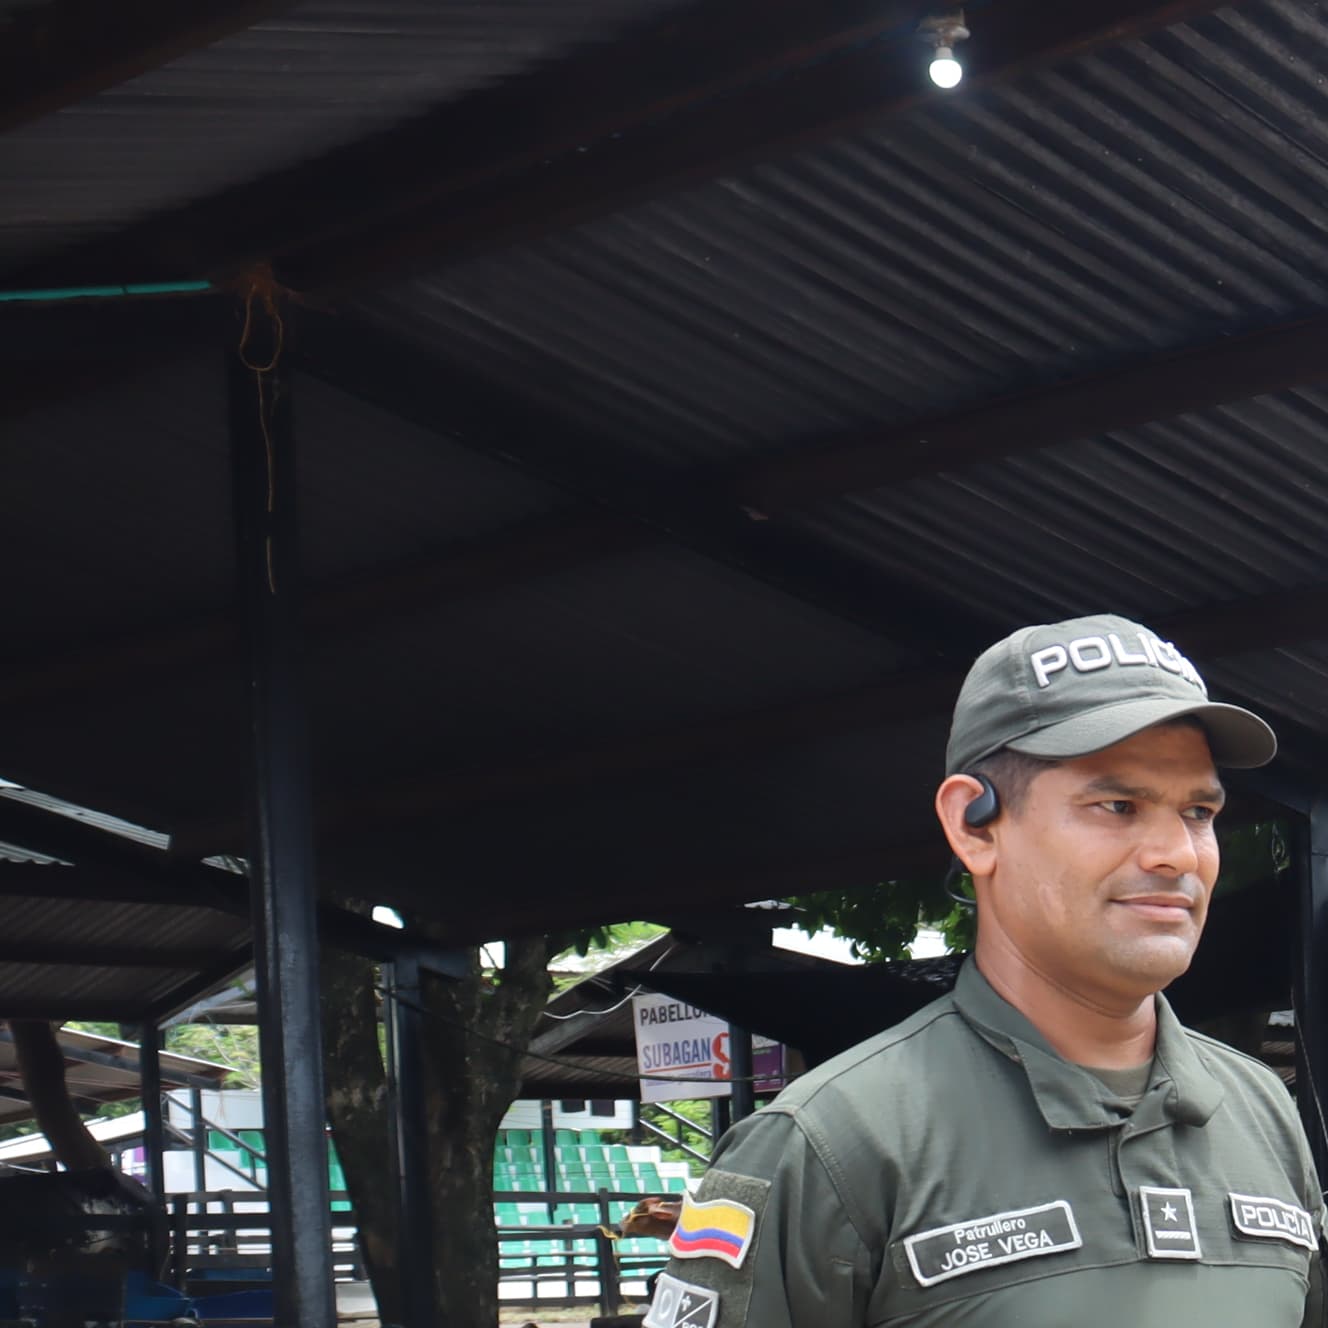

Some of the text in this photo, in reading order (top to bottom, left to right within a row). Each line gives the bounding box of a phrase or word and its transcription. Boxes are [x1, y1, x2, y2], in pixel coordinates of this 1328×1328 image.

[639, 1003, 707, 1026] PABELLO
[954, 1218, 1026, 1244] Patrullero
[941, 1229, 1054, 1271] JOSE VEGA
